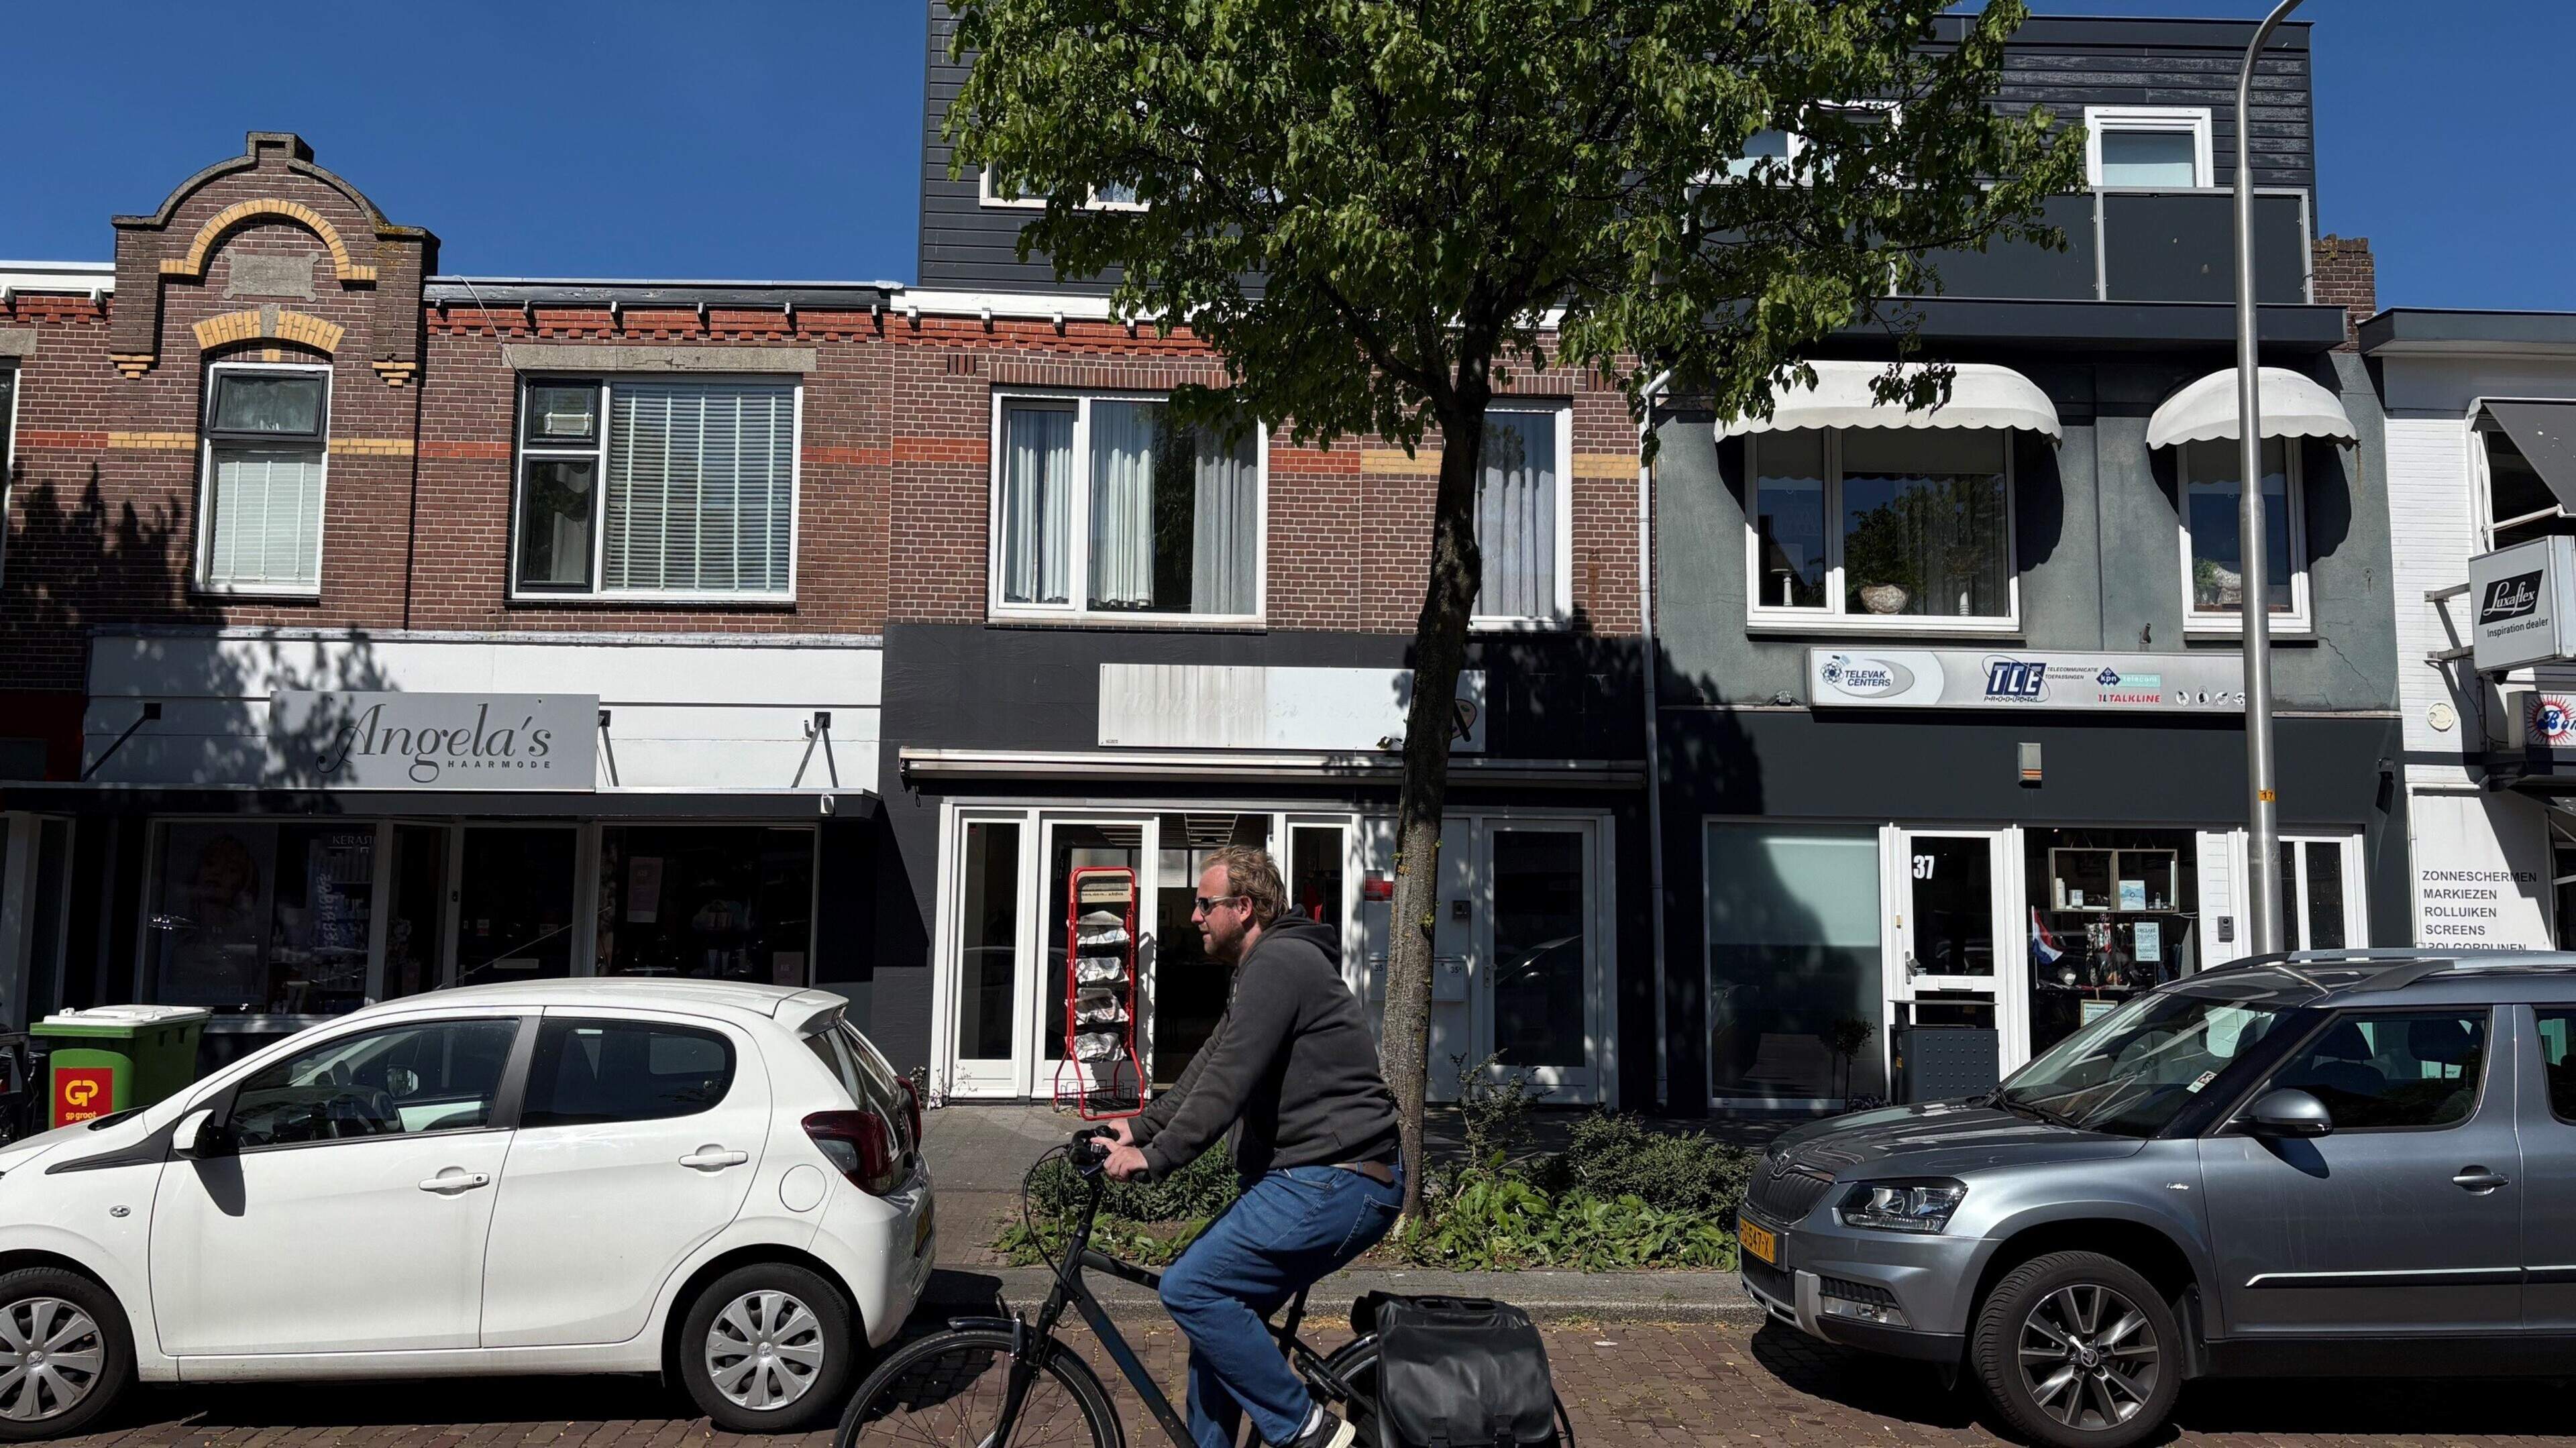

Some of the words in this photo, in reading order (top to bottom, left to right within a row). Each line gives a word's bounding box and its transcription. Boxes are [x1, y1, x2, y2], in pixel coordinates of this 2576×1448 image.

[2482, 581, 2536, 616] Luxaflex
[2487, 623, 2524, 638] Inspiration
[2526, 618, 2548, 630] dealer
[1845, 670, 1886, 679] TELEVAK
[2100, 674, 2117, 683] kpn
[1847, 679, 1891, 687] CENTERS
[2109, 694, 2160, 703] TALKLINE
[316, 703, 551, 783] Angela's
[447, 760, 551, 769] HAARMODE
[1913, 854, 1935, 879] 37
[2422, 871, 2537, 883] ZONNESCHERMEN
[2424, 889, 2497, 899] MARKIEZEN
[2425, 907, 2497, 917] ROLLUIKEN
[2425, 924, 2485, 936] SCREENS
[65, 1079, 99, 1107] GP
[65, 1112, 74, 1121] gp
[75, 1111, 97, 1121] groot
